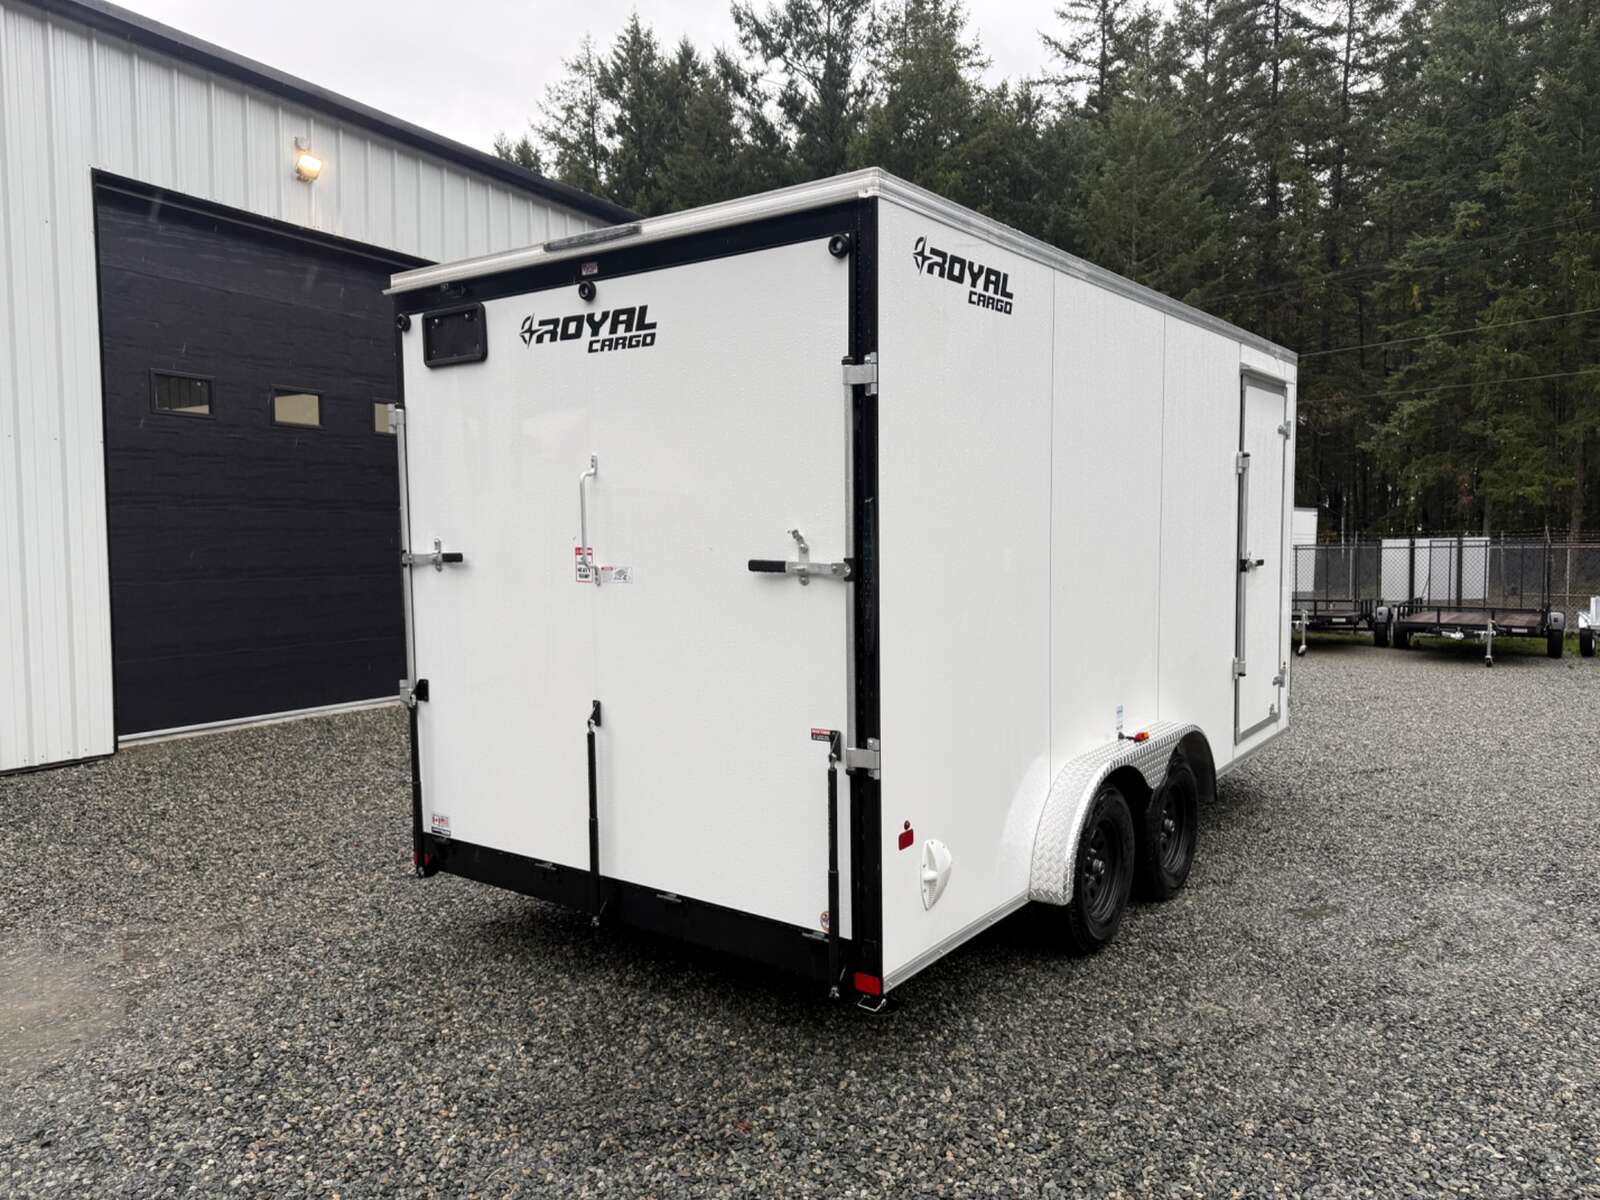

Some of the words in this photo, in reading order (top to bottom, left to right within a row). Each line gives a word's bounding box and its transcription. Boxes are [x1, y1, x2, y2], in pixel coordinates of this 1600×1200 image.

[927, 247, 1014, 300] ROYAL
[968, 290, 1013, 315] CARGO
[535, 305, 657, 344] ROYAL
[588, 332, 657, 354] CARGO
